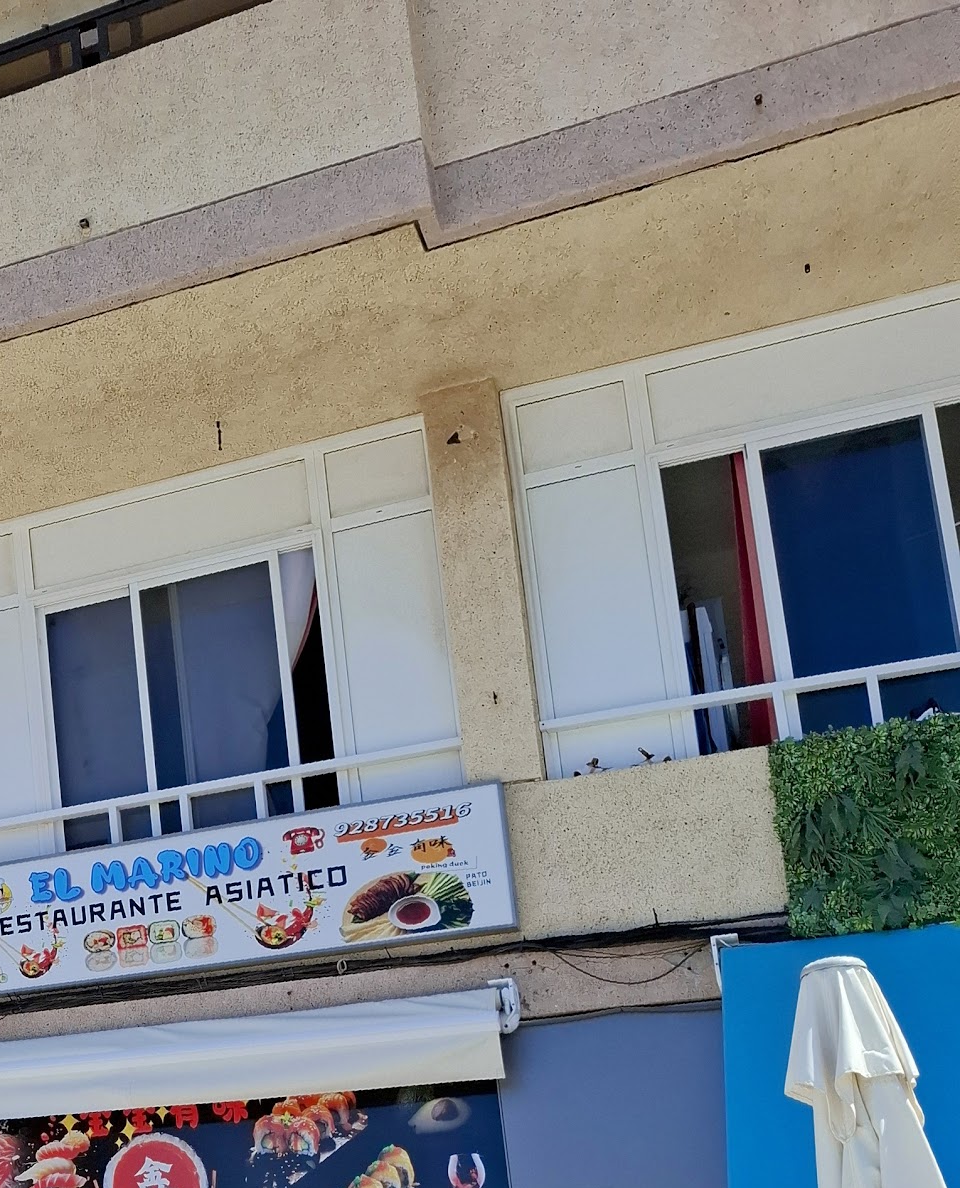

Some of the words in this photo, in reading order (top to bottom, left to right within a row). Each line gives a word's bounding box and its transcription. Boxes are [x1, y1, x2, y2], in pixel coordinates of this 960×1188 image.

[334, 802, 472, 837] 928735516
[28, 867, 84, 904] EL
[91, 837, 264, 895] MARINO
[449, 860, 469, 868] duck
[205, 865, 348, 906] ASIATICO
[466, 871, 488, 880] PATO
[467, 878, 491, 888] BEIJIN
